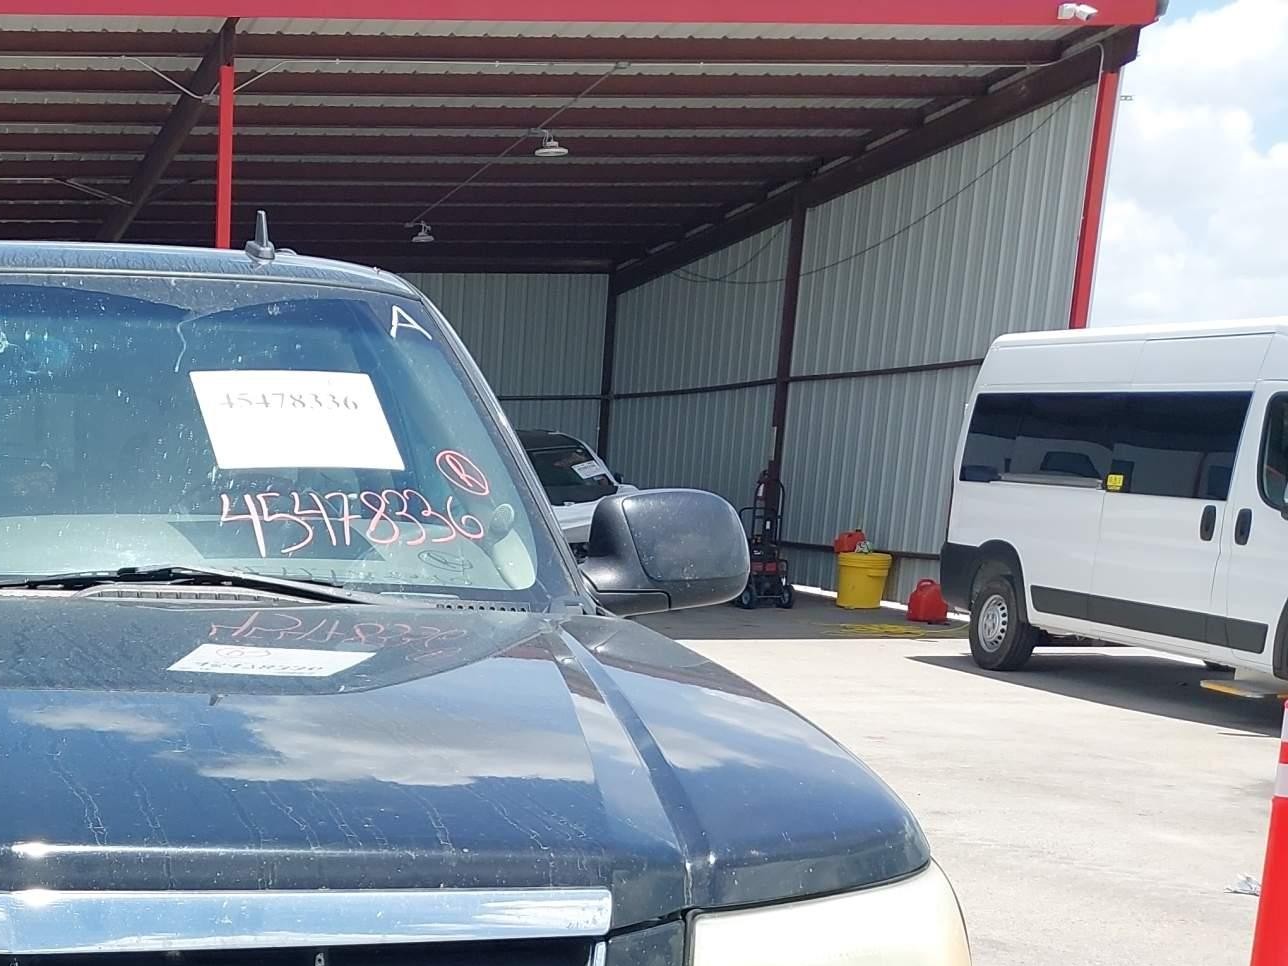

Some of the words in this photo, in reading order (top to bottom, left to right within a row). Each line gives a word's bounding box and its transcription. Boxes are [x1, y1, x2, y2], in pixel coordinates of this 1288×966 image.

[390, 305, 433, 341] A
[218, 392, 359, 411] 45478336
[220, 490, 485, 558] 45478336
